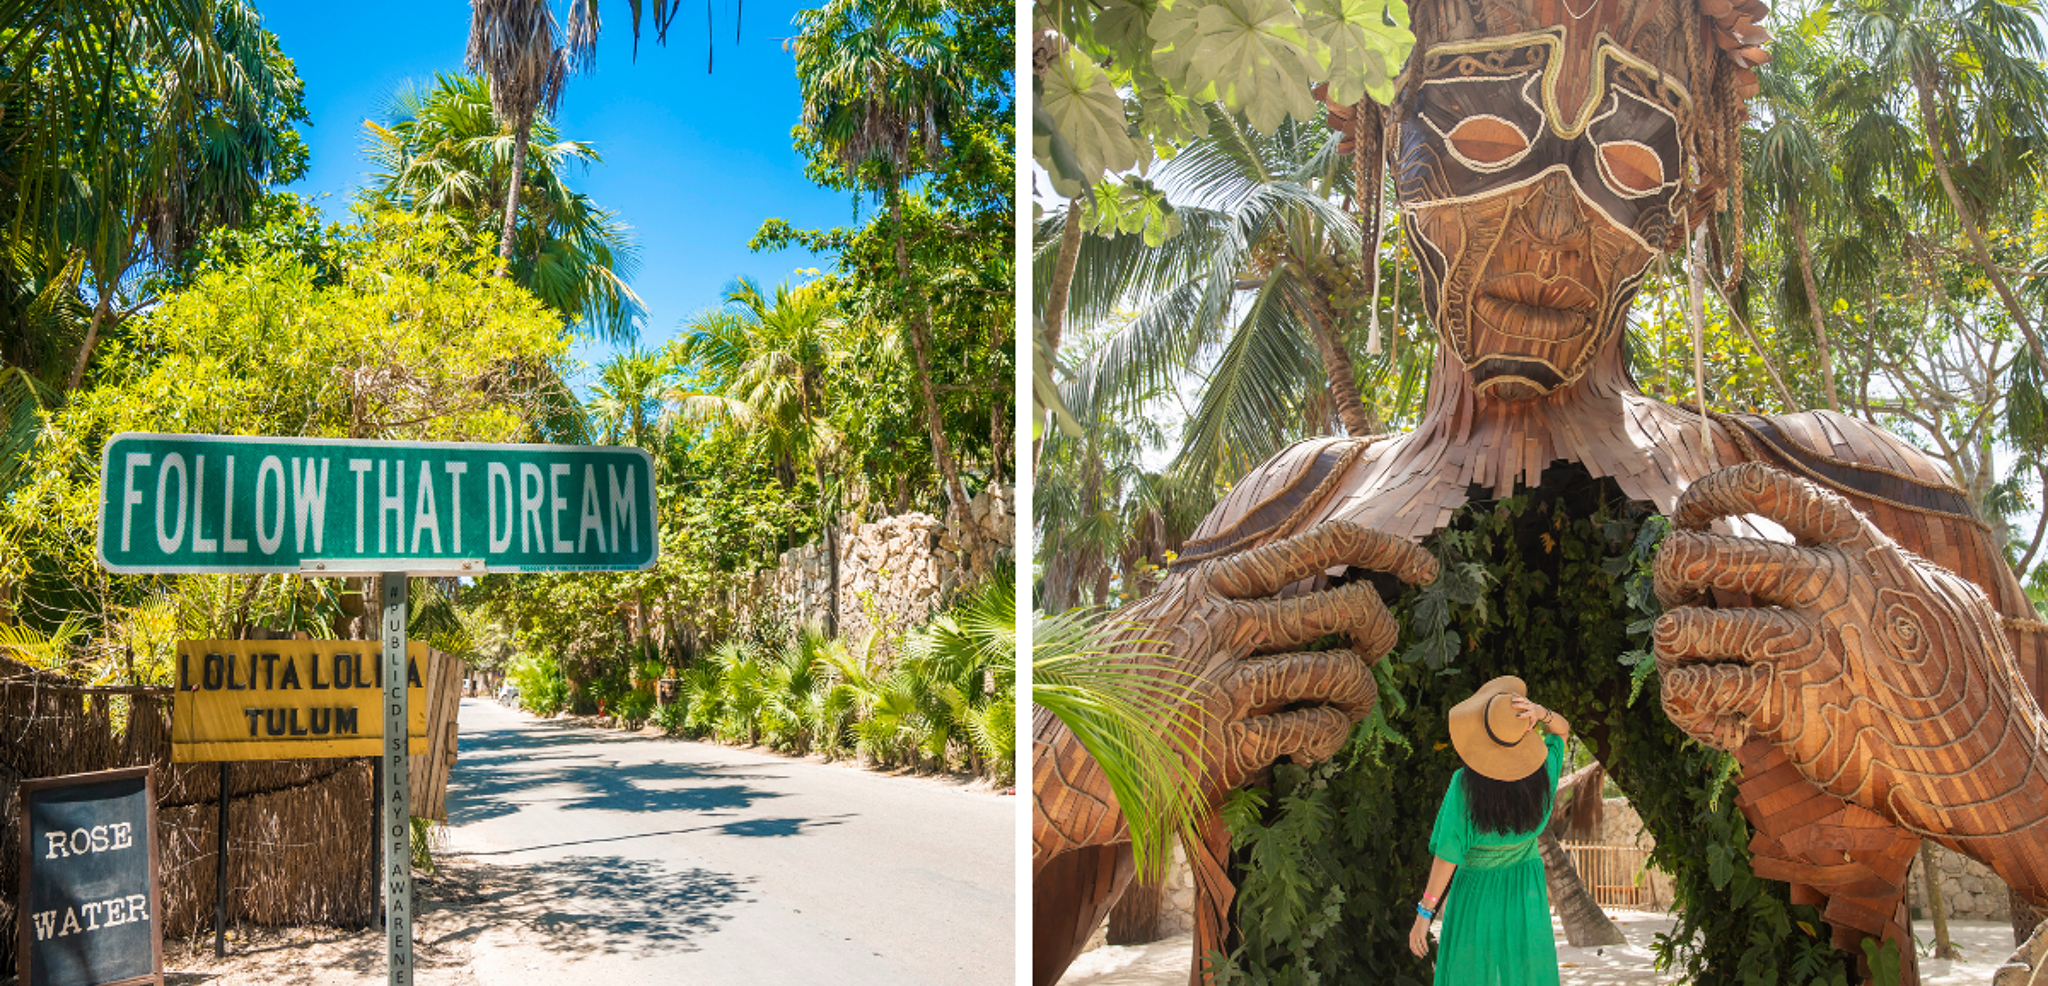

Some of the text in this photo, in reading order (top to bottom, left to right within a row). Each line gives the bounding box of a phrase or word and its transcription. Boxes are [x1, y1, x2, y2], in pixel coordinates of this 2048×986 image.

[120, 452, 640, 555] FOLLOW THAT DREAM
[180, 652, 424, 691] LOLITA LOLIA
[245, 706, 359, 737] TULUM
[44, 822, 132, 859] ROSE
[32, 894, 149, 941] WATER
